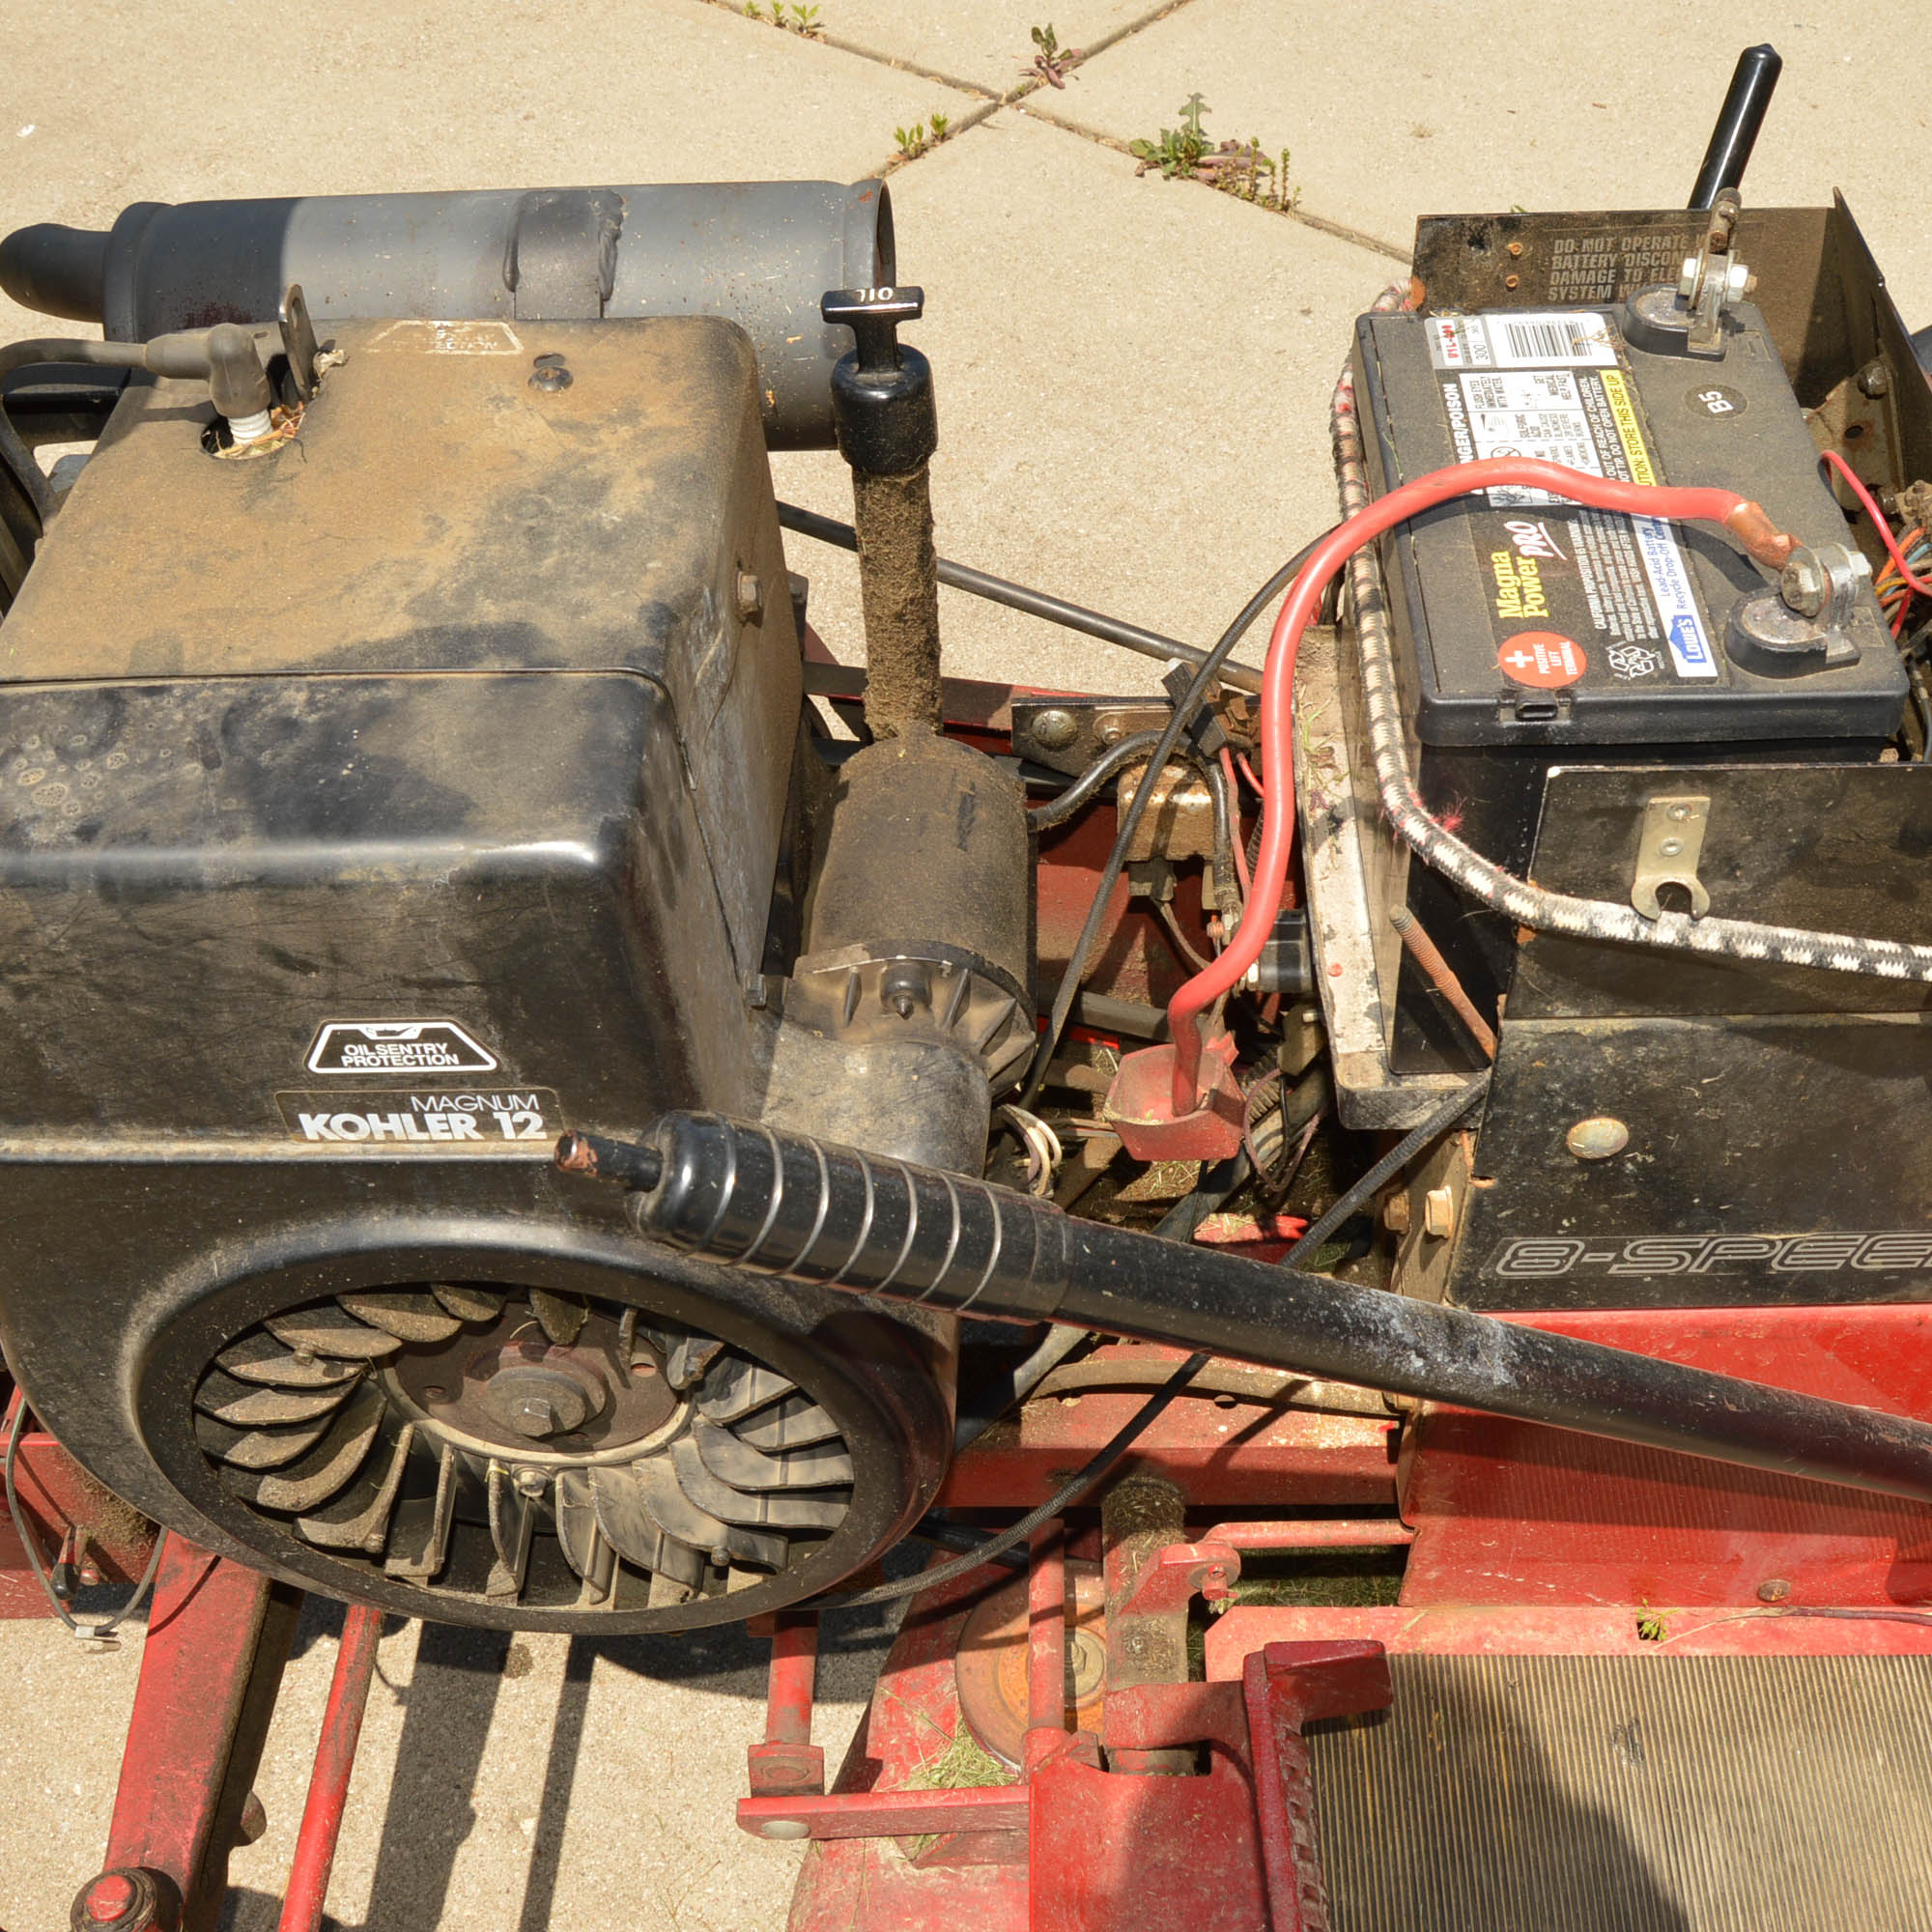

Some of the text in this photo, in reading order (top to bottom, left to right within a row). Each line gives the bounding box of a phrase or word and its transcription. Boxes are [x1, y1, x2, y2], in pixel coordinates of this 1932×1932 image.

[1554, 239, 1573, 254] DO
[1581, 238, 1614, 253] NOT
[1621, 234, 1689, 251] OPERATE
[1552, 253, 1617, 270] BATTERY
[1550, 270, 1616, 285] DAMAGE
[1623, 269, 1642, 282] TO
[855, 286, 894, 302] OIL
[1548, 285, 1611, 301] SYSTEM
[1473, 345, 1488, 360] 300
[1698, 391, 1733, 413] B5
[1588, 413, 1600, 423] OF
[1597, 409, 1613, 427] OPEN
[1443, 384, 1483, 491] NGER/POISON
[1593, 424, 1608, 448] REACH
[1605, 376, 1653, 486] UTION: STORE THIS SIDE UP
[1605, 429, 1618, 443] NOT
[1601, 449, 1612, 458] OF
[1610, 444, 1622, 455] DO
[1604, 460, 1617, 476] OUT
[1641, 526, 1670, 597] Lead-Acid Battery
[1660, 543, 1677, 577] Drop-Off
[1492, 552, 1523, 618] Magna
[1577, 554, 1597, 594] PROPOSITION
[1516, 556, 1549, 618] Power
[1670, 579, 1688, 610] Recycle
[1586, 594, 1607, 629] CALIFORNIA
[1677, 618, 1703, 660] LOWE'S
[1533, 643, 1550, 673] POSITIVE
[1548, 651, 1562, 667] LEFT
[1559, 641, 1577, 675] TERMINAL
[341, 1054, 459, 1066] PROTECTION
[411, 1094, 539, 1112] MAGNUM
[298, 1112, 548, 1141] KOHLER 12
[1496, 1235, 1932, 1276] 8-SPEE
